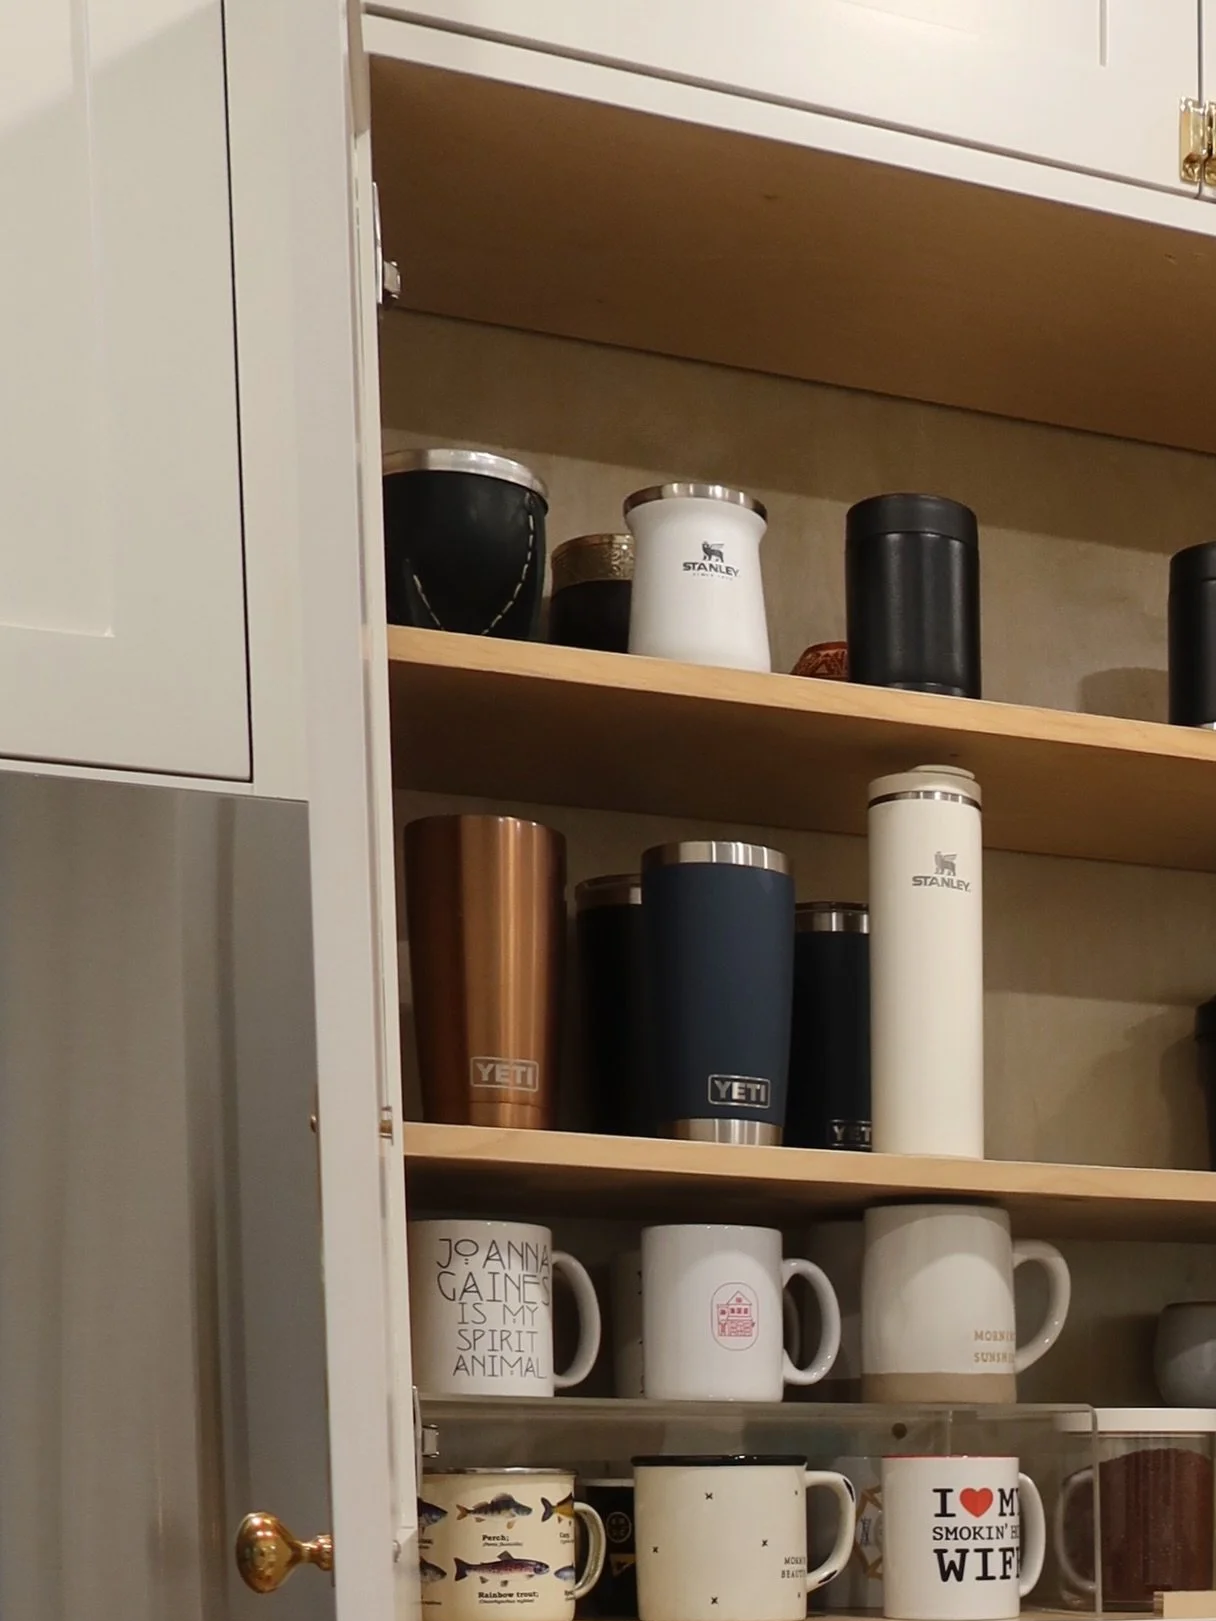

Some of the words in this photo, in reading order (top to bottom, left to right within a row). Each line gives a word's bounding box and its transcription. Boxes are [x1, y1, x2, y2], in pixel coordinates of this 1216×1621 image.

[682, 561, 740, 577] STANLEY
[911, 875, 971, 892] STANLEY
[475, 1062, 535, 1086] YETI
[714, 1079, 767, 1102] YETI
[833, 1125, 872, 1142] YET
[436, 1238, 550, 1274] JOANNA
[436, 1270, 550, 1306] GAINES
[457, 1302, 487, 1325] IS
[503, 1303, 539, 1326] MY
[456, 1328, 539, 1353] SPIRIT
[452, 1354, 547, 1379] ANIMAL
[932, 1488, 956, 1518] I
[932, 1523, 1008, 1541] SMOKIN'
[478, 1591, 514, 1599] Rainbow
